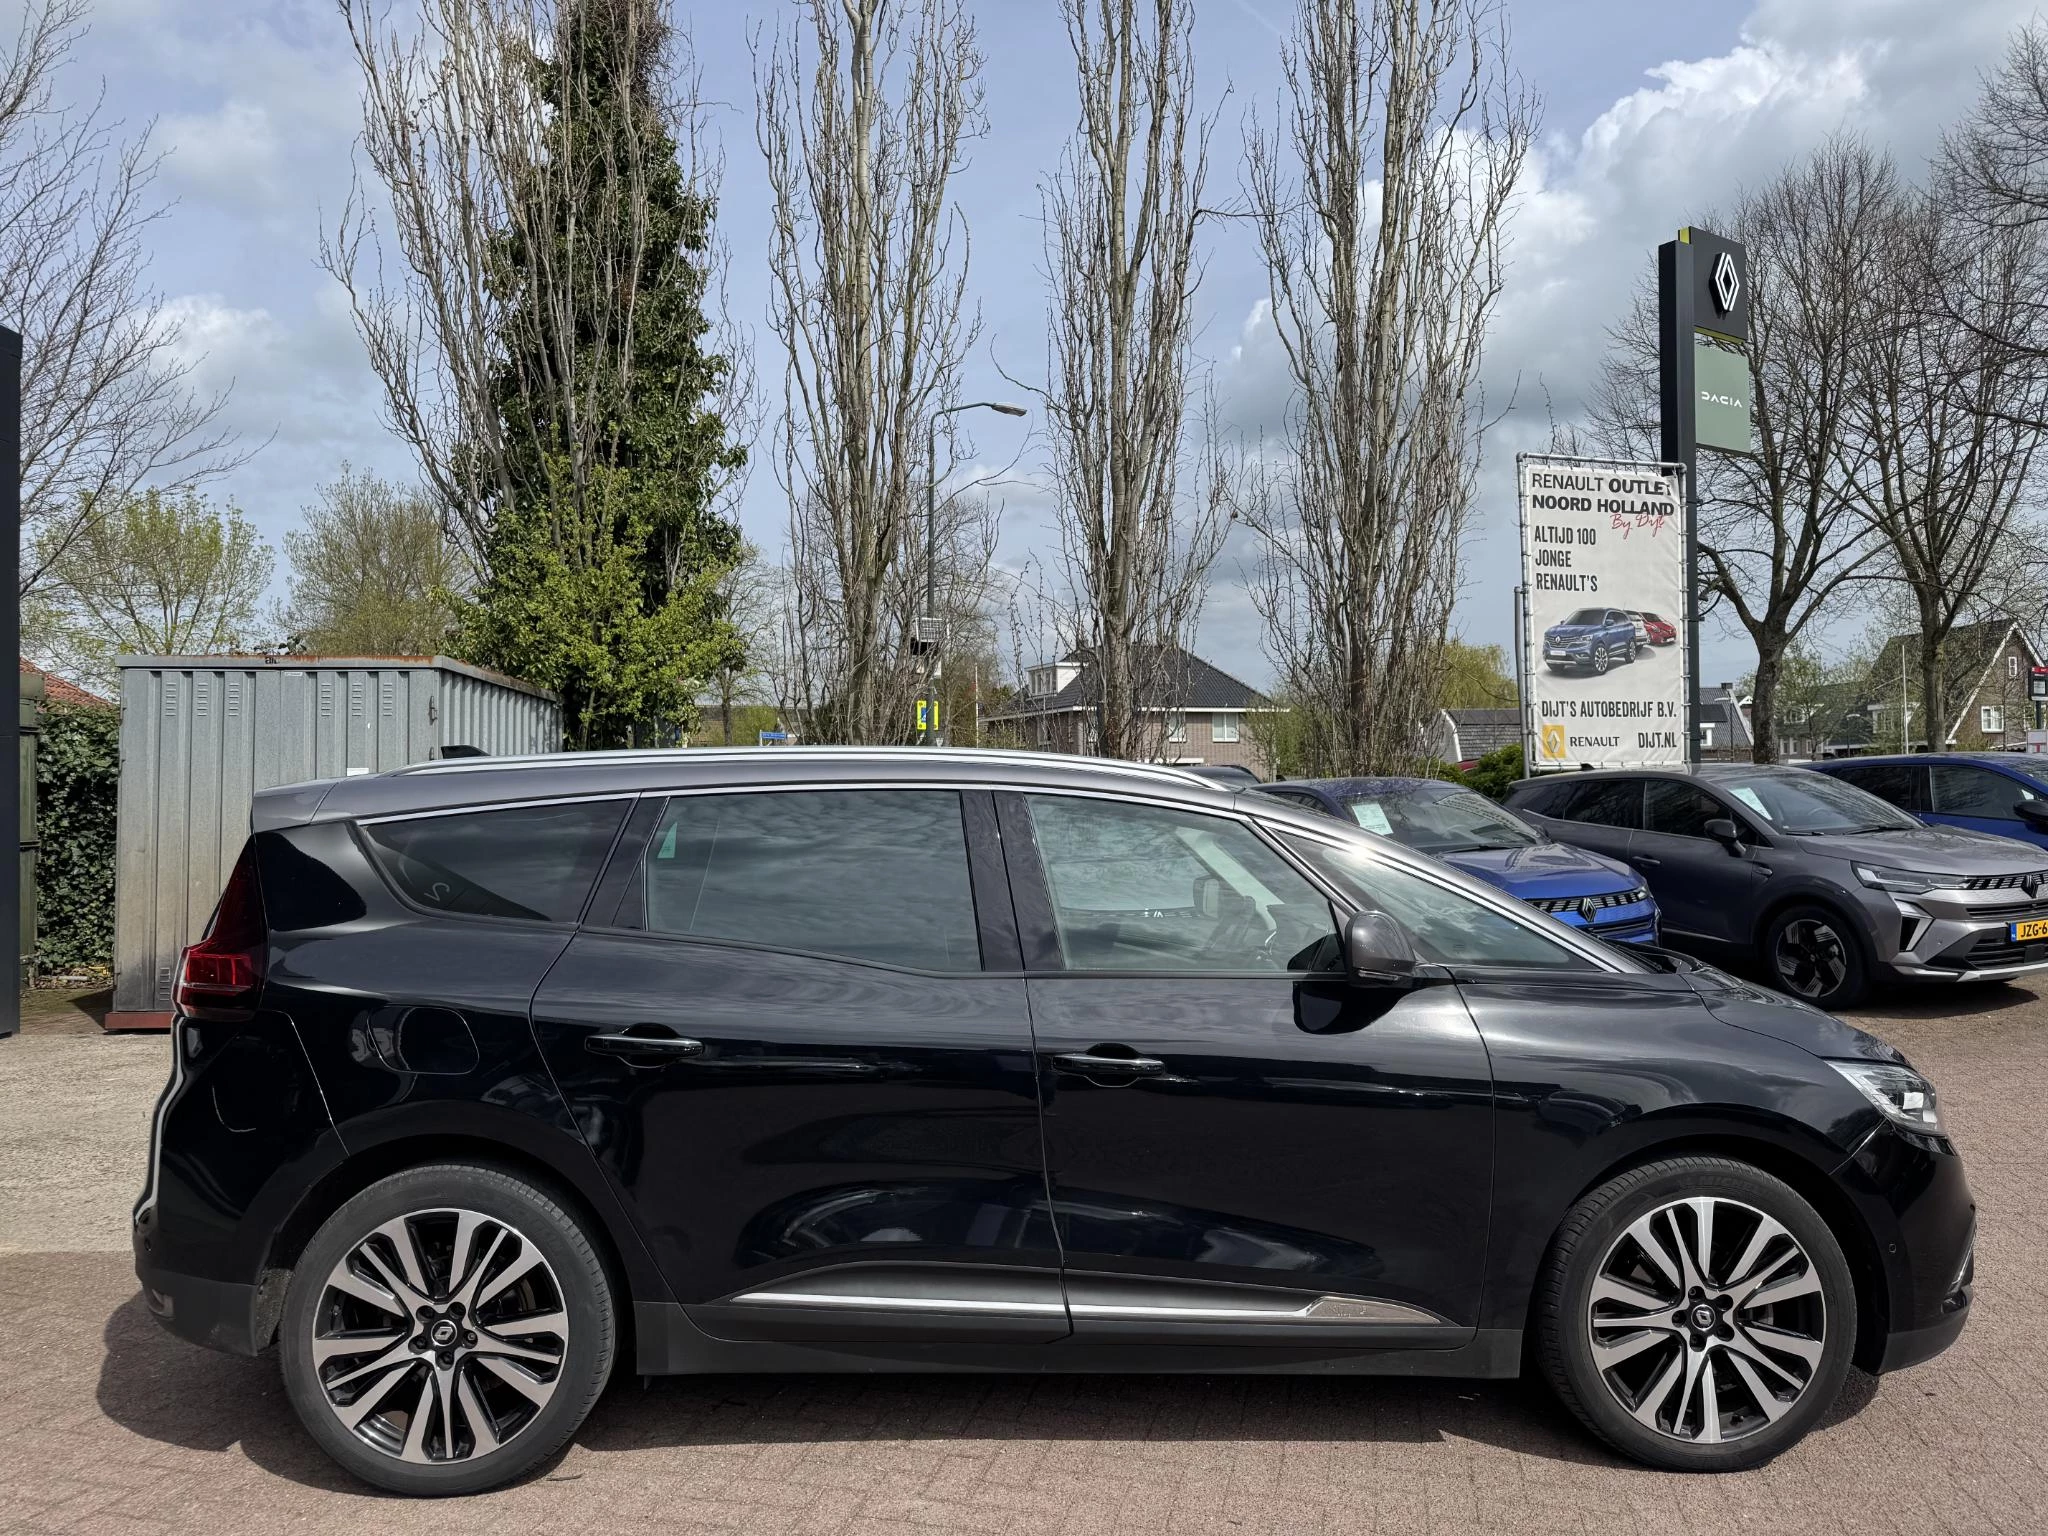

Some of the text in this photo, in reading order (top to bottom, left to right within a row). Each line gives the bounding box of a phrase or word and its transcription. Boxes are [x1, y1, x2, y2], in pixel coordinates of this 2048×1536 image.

[1701, 391, 1743, 408] DACIA
[1532, 473, 1604, 492] RENAULT
[1532, 495, 1675, 516] NOORD HOLLAND
[1534, 525, 1596, 545] ALTIJD 100
[1610, 513, 1633, 540] By
[1535, 549, 1572, 567] JONGE
[1536, 573, 1598, 592] RENAULT'S
[1541, 700, 1677, 718] DIJT'S AUTOBEDRIJF B.V.
[1569, 736, 1620, 747] RENAULT
[1638, 732, 1677, 748] DIJT.NL
[2020, 922, 2048, 938] JZG-6
